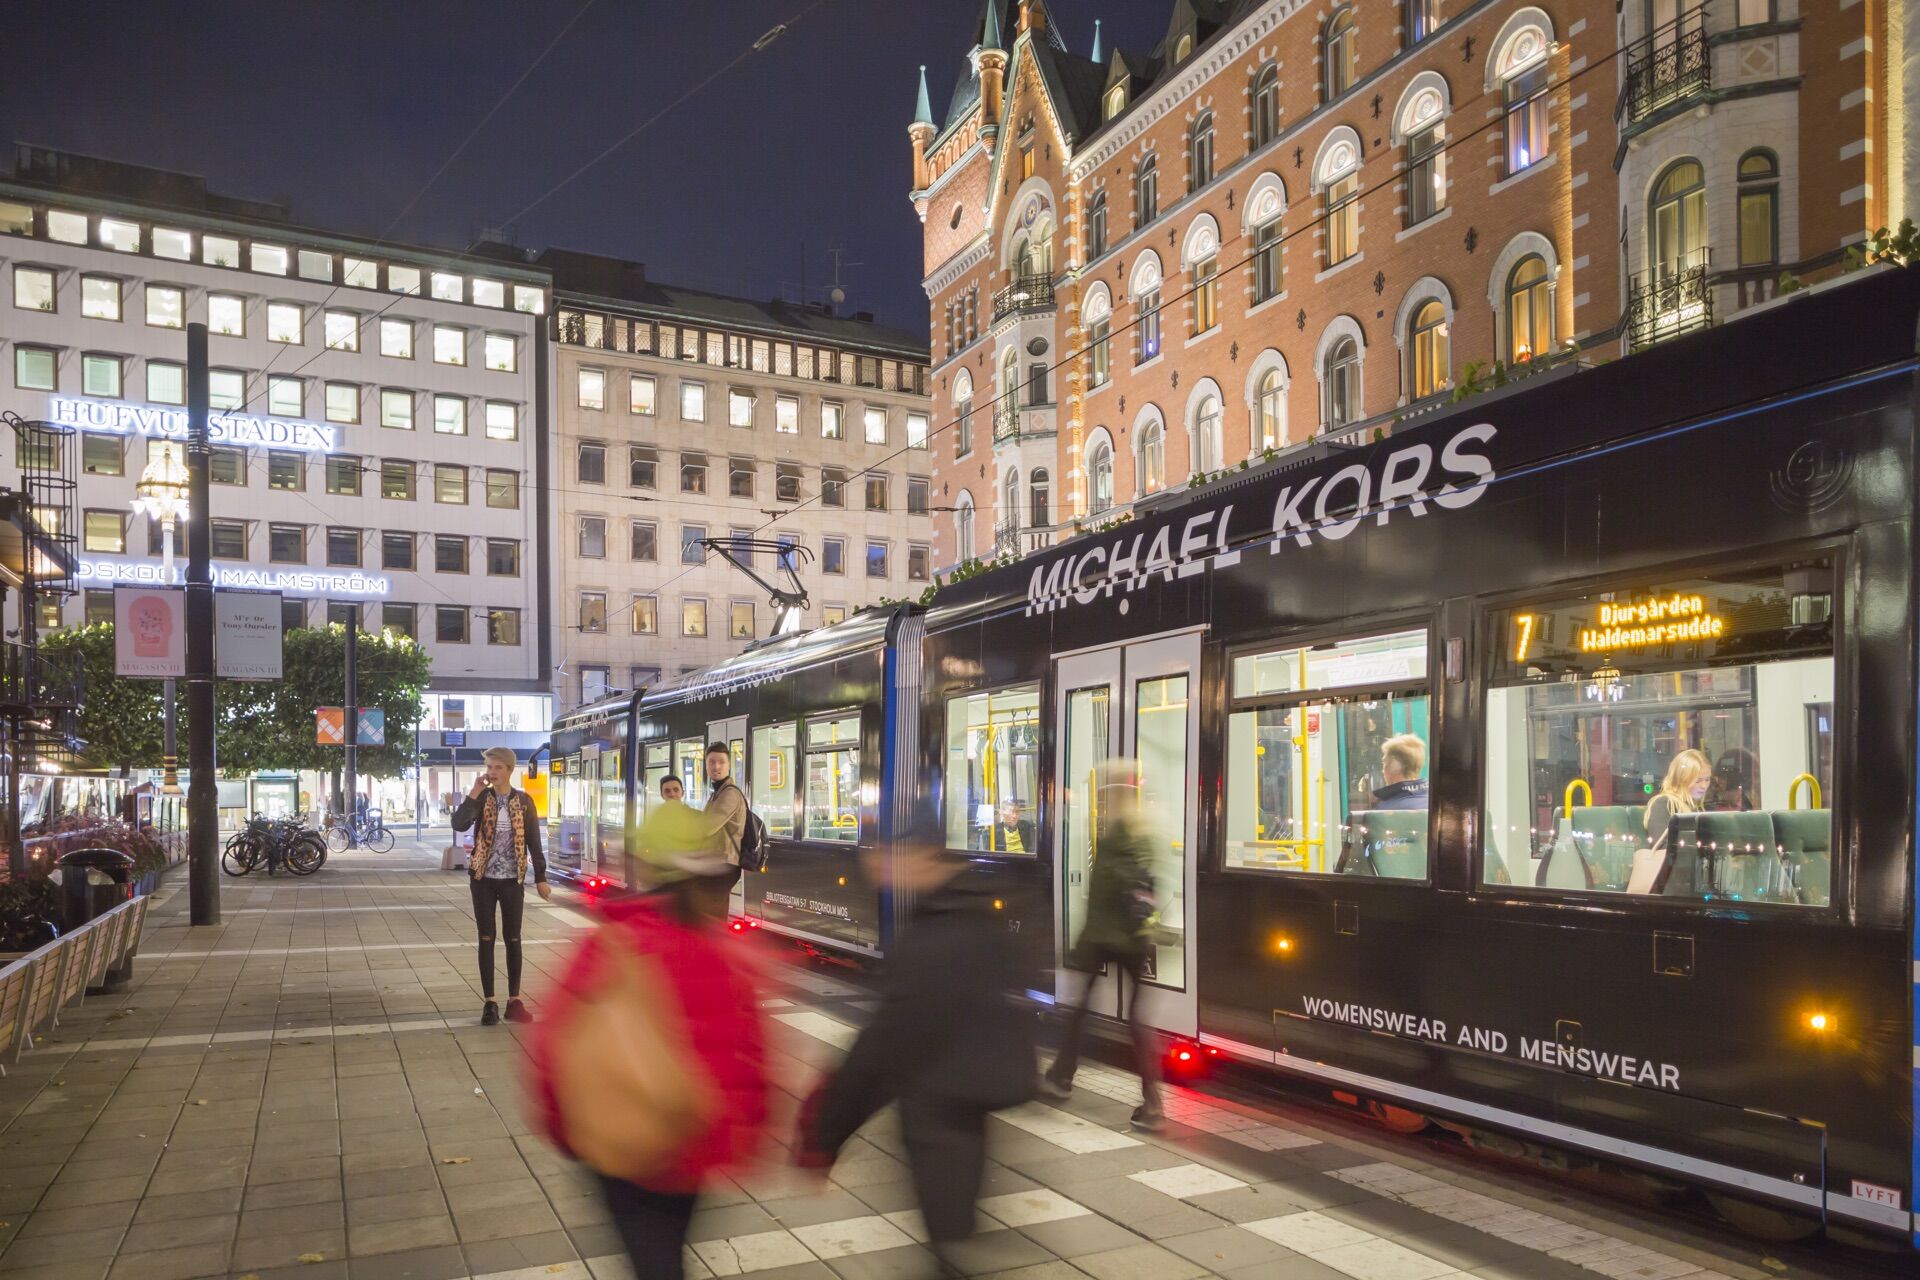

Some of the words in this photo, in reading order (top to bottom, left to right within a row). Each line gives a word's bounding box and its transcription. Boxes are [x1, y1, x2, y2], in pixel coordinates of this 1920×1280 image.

[55, 400, 334, 448] HUFVUSTADEN
[1025, 504, 1241, 616] MICHAEL
[1270, 423, 1498, 555] KORS
[224, 571, 385, 592] MALMSTRÖM
[1600, 593, 1703, 626] Djurgården
[1517, 615, 1533, 661] 7
[1582, 614, 1723, 651] Waldemarsudde
[121, 663, 168, 672] MAGASIN
[222, 665, 265, 674] MAGASIN
[809, 900, 836, 915] STOCKHOLM
[1302, 995, 1447, 1041] WOMENSWEAR
[1457, 1025, 1508, 1053] AND
[1520, 1037, 1681, 1090] MENSWEAR
[1856, 1185, 1895, 1204] LYFT
